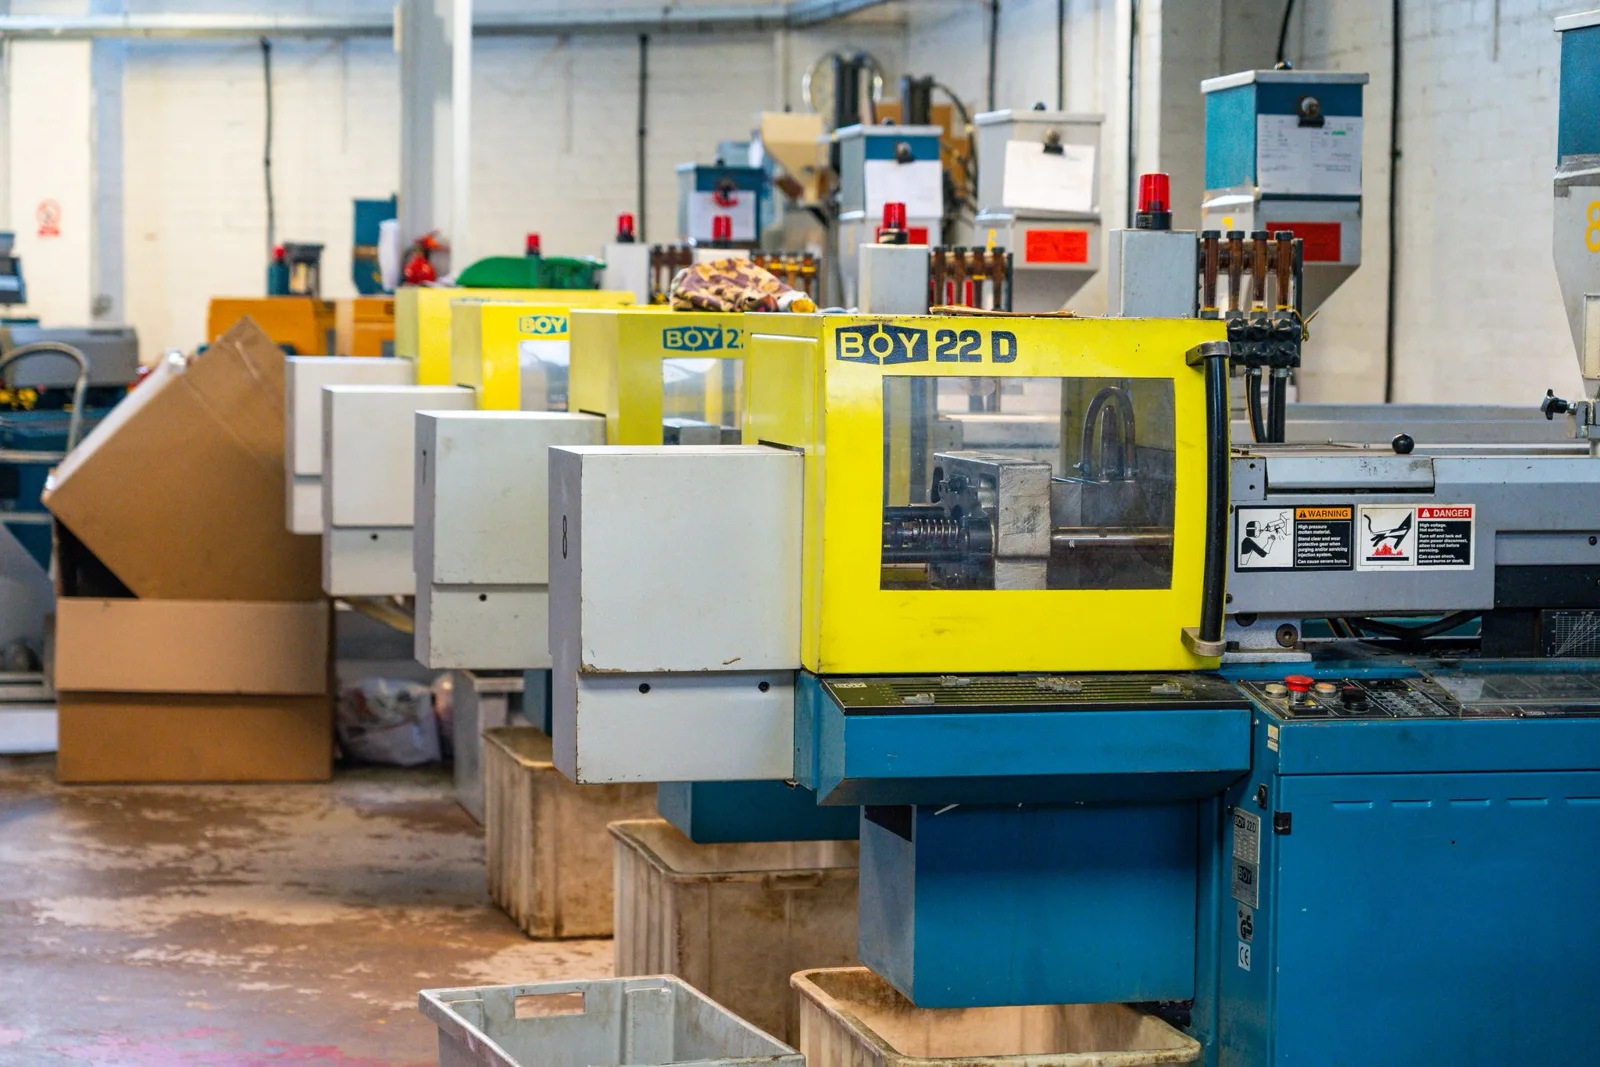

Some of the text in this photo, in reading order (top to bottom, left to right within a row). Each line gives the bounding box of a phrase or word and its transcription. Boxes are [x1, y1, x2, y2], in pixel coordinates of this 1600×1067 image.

[519, 315, 567, 334] BOY
[664, 328, 744, 349] BOY 2
[838, 328, 1018, 363] BOY 22 D
[1308, 510, 1348, 518] WARNING
[1433, 509, 1469, 517] DANGER
